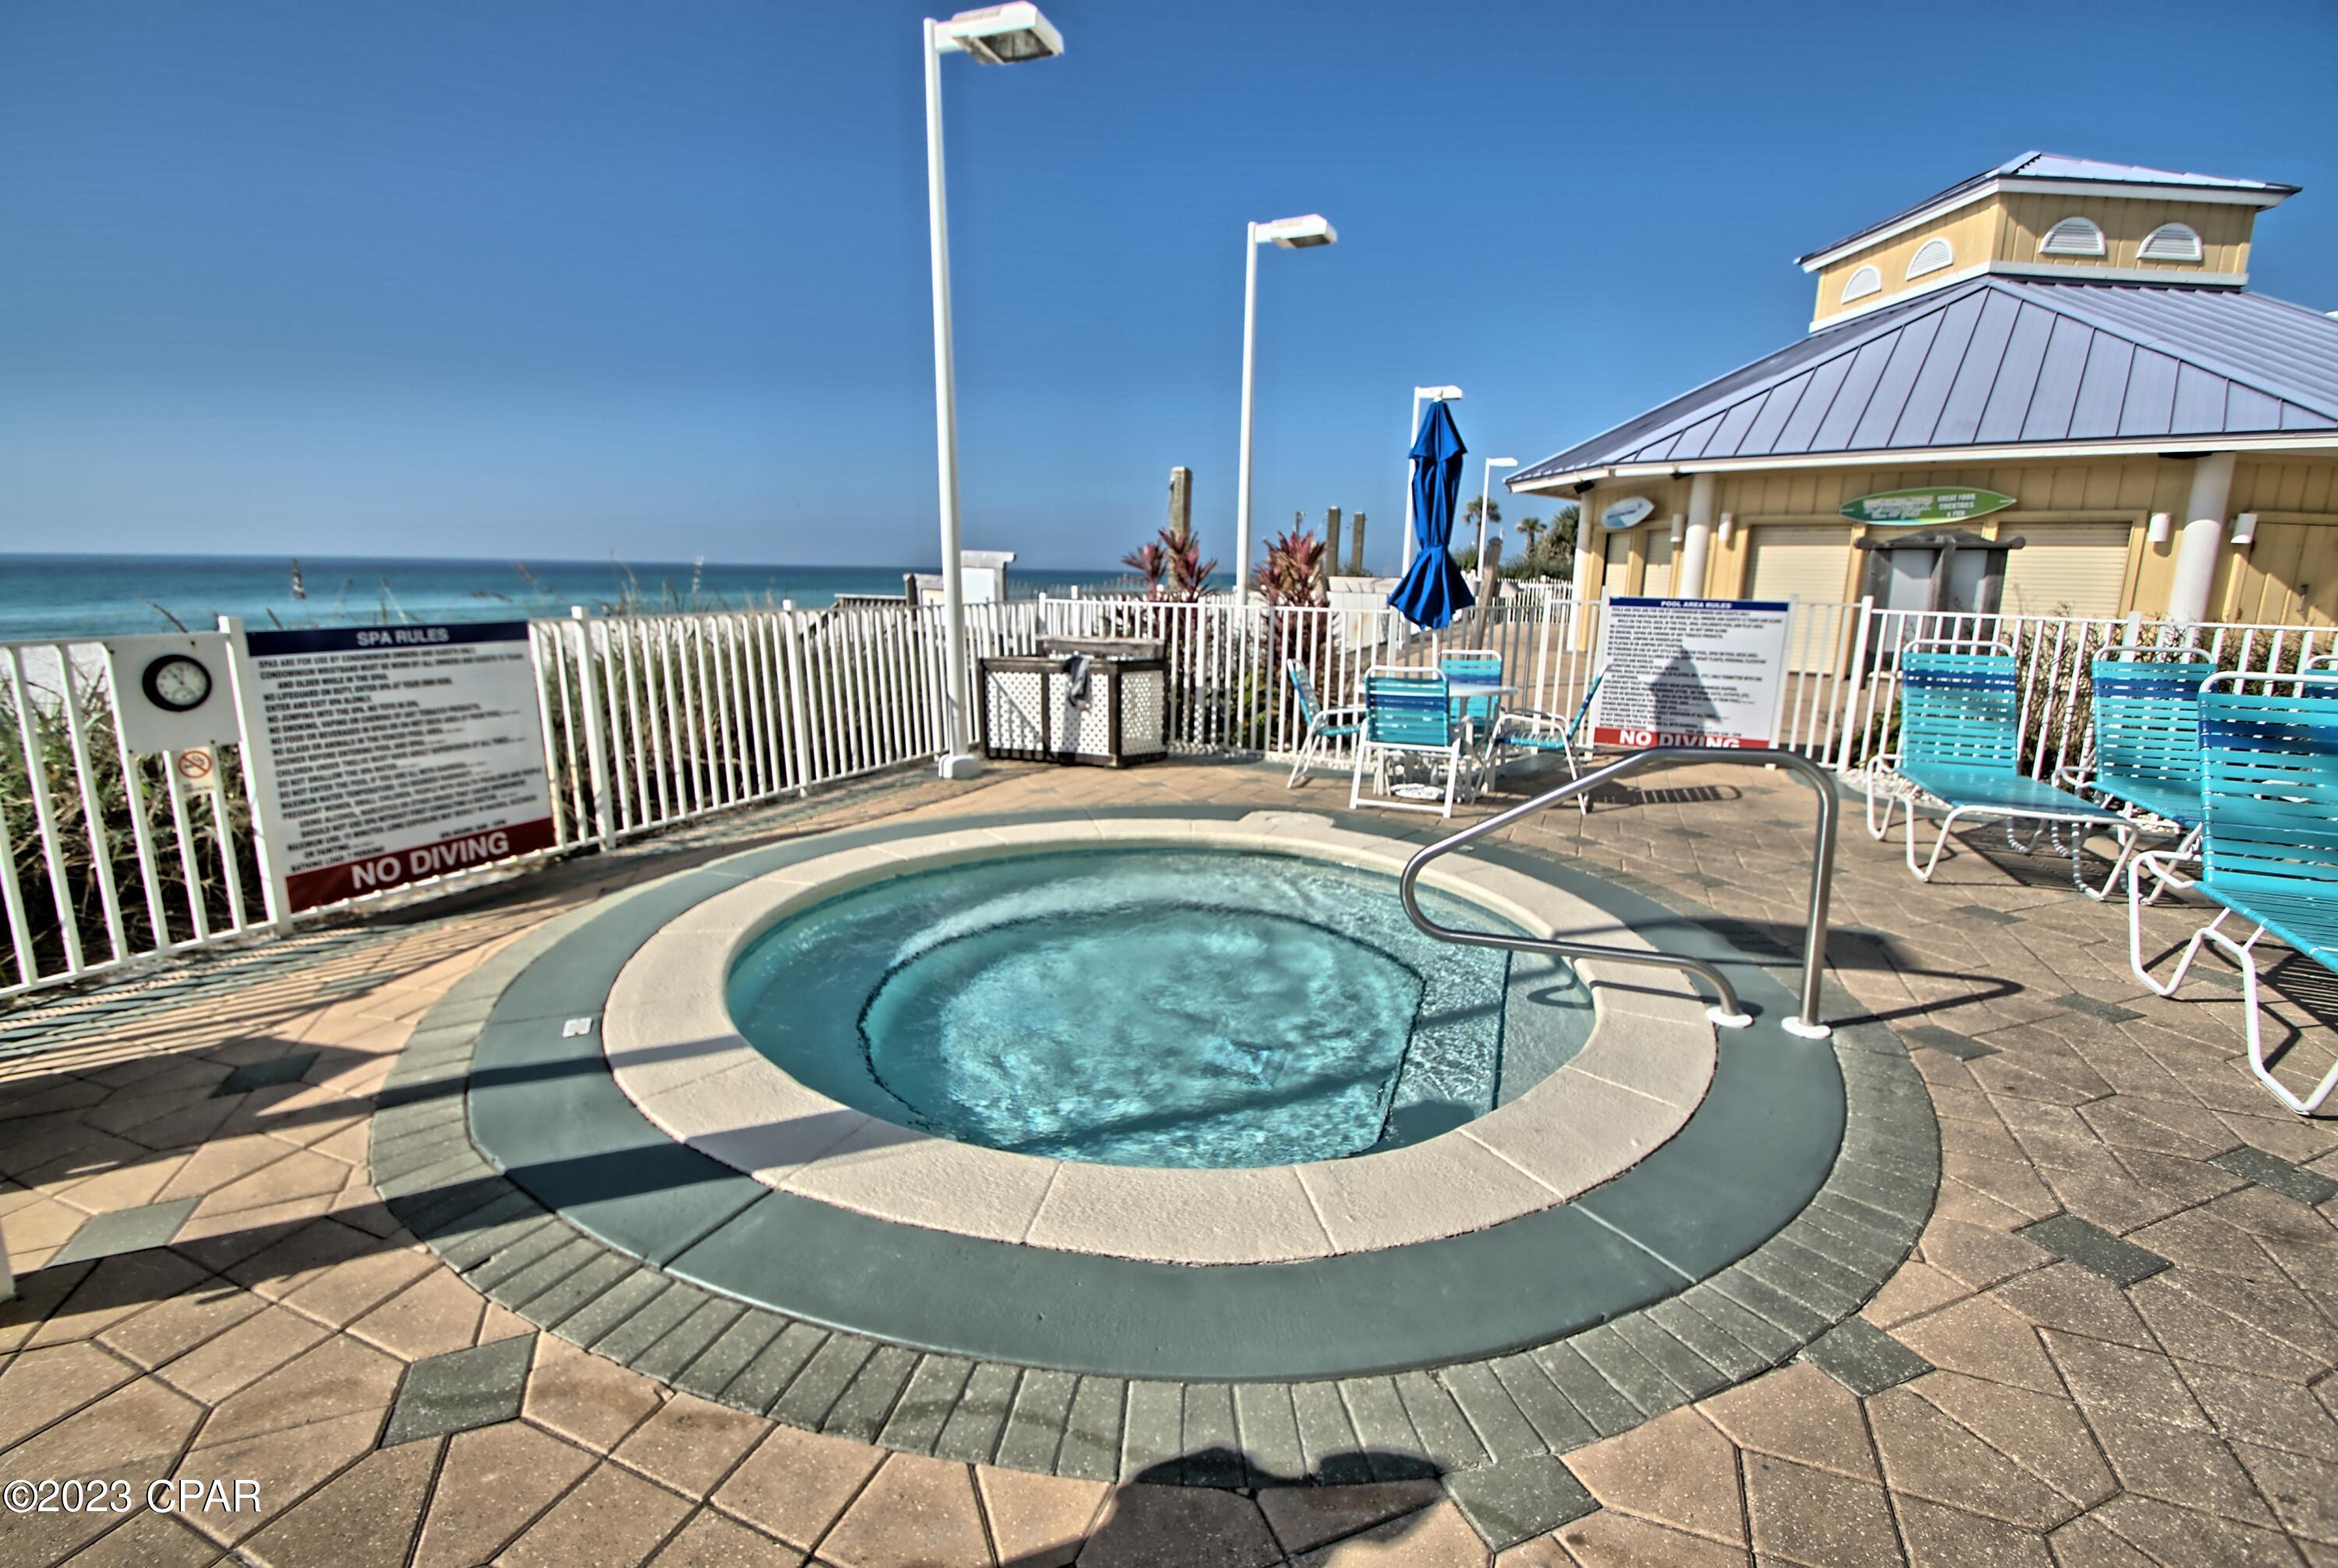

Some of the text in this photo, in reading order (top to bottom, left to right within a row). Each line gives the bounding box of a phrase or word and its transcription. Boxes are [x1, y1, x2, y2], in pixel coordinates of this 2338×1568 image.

[356, 628, 450, 647] SPA RULES
[1619, 729, 1740, 748] NO DIVING
[351, 832, 510, 889] NO DIVING
